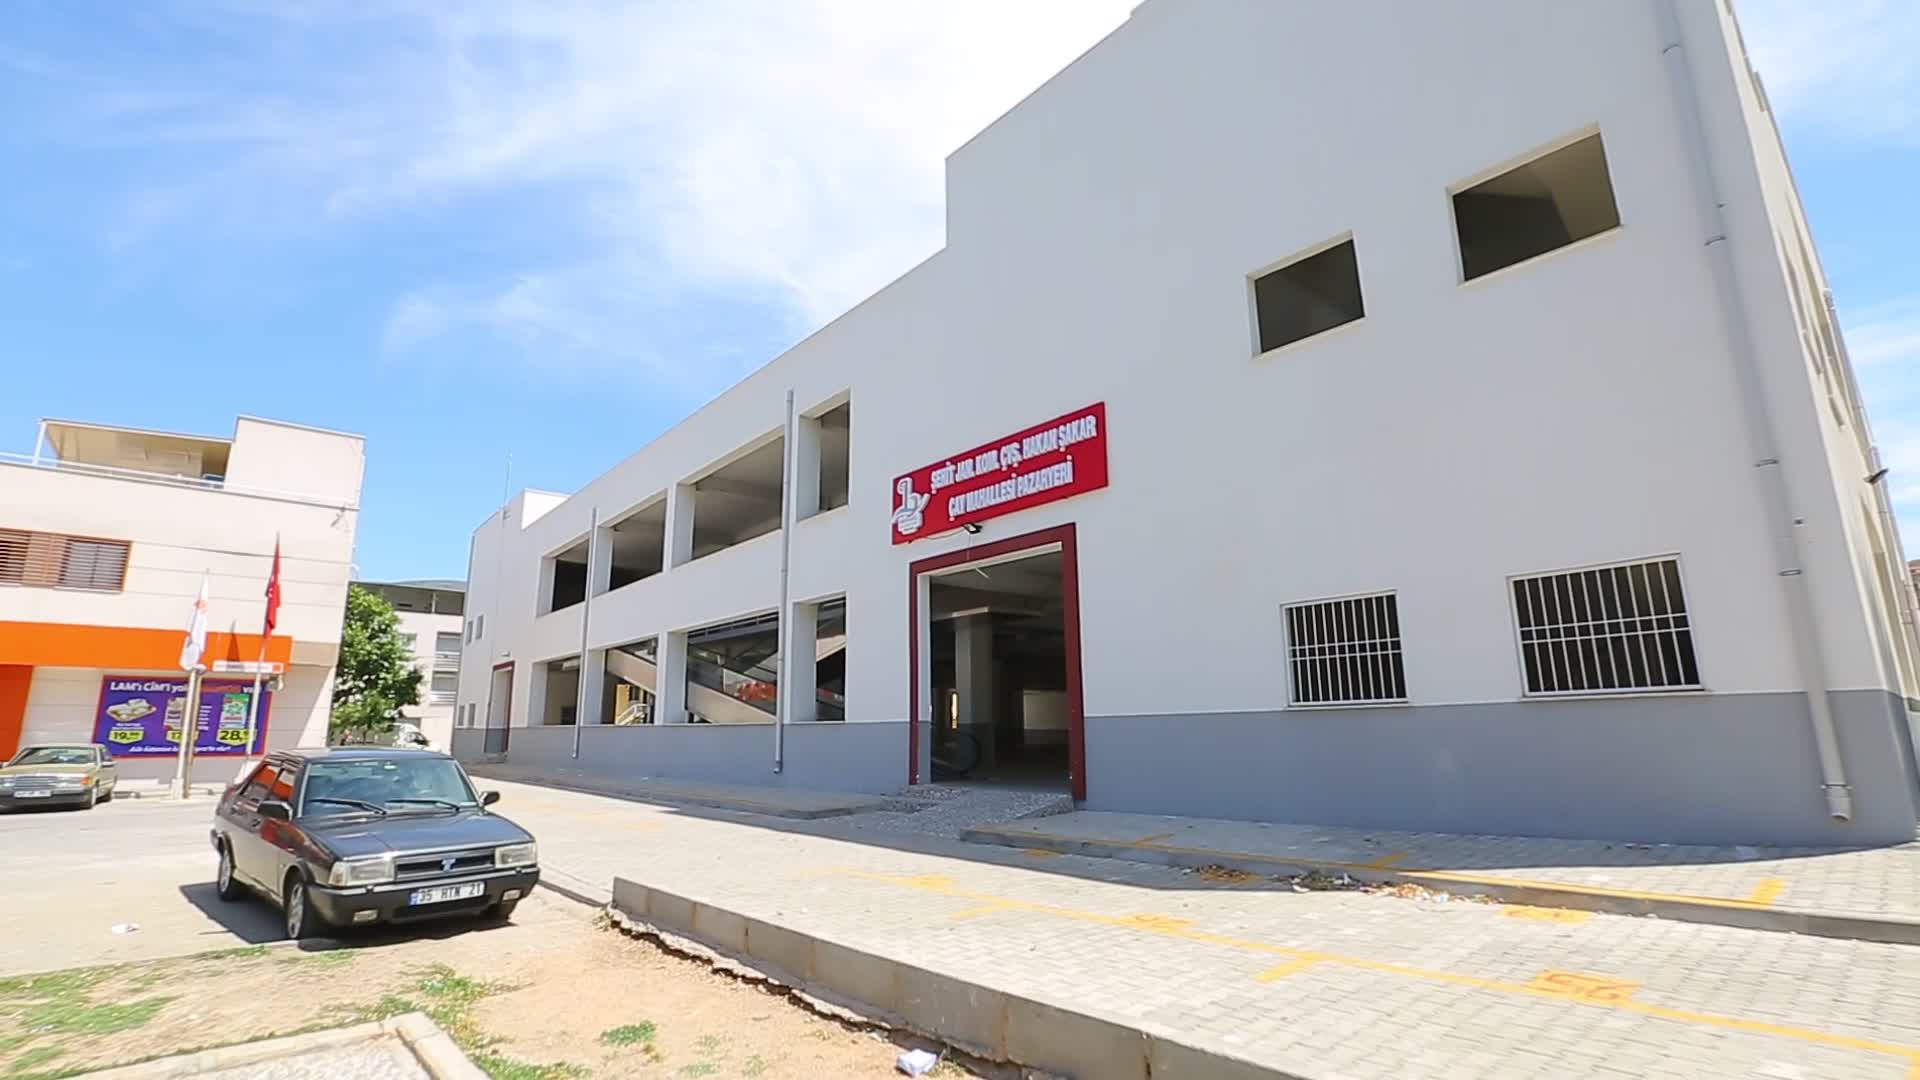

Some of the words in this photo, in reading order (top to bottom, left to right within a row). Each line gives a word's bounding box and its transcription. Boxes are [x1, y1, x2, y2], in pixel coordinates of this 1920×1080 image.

[1022, 427, 1058, 459] HAKAN
[1058, 414, 1097, 452] ŞAKAR
[1016, 454, 1073, 492] PAZARYERİ
